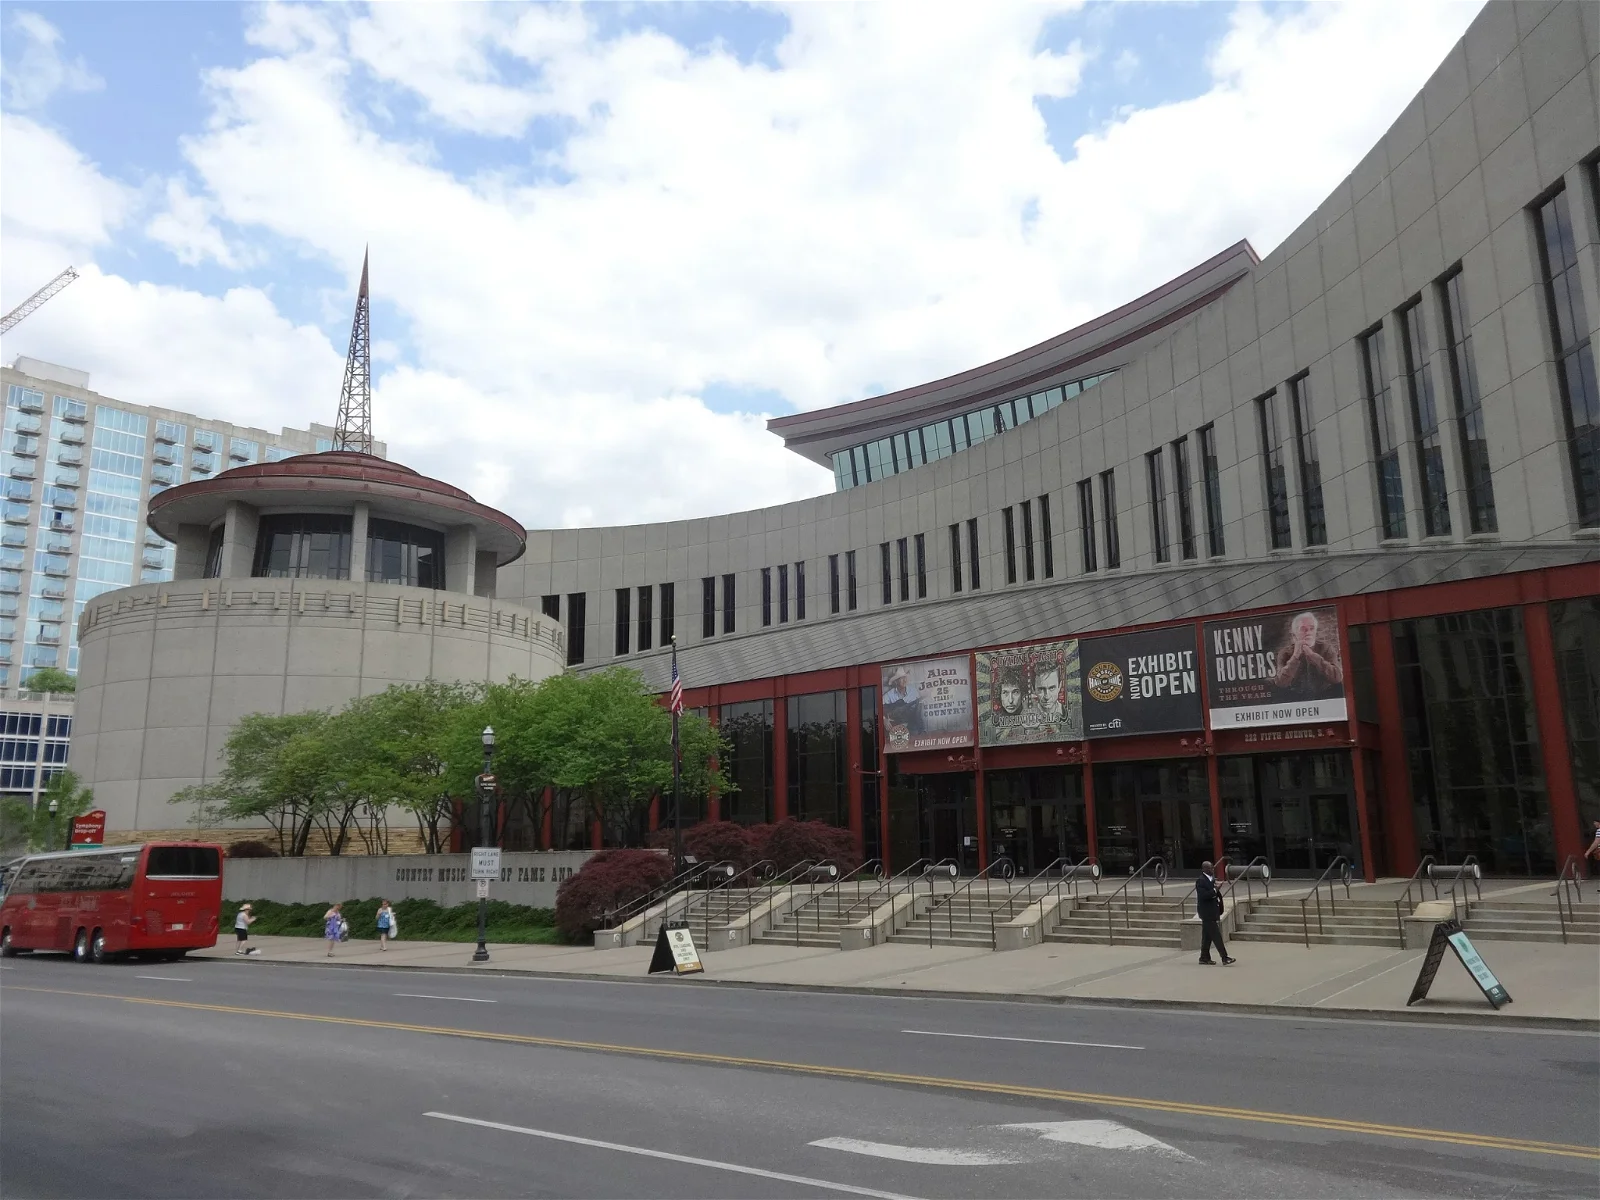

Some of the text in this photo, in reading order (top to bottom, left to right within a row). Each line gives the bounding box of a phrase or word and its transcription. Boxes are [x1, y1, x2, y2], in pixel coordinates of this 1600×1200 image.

[1213, 625, 1262, 654] KENNY
[1128, 651, 1192, 675] EXHIBIT
[1216, 652, 1276, 682] ROGERS
[927, 668, 957, 679] Alan
[918, 678, 968, 691] Jackson
[937, 687, 949, 695] 25
[1129, 677, 1140, 699] NOW
[1141, 671, 1196, 698] OPEN
[1219, 684, 1264, 694] THROUGH
[1219, 692, 1272, 701] THE YEARS
[923, 708, 966, 717] COUNTRY
[1235, 707, 1319, 721] EXHIBIT NOW OPEN
[1108, 718, 1122, 729] citi
[914, 735, 968, 747] EXHIBIT NOW OPEN
[1245, 733, 1257, 742] 222
[1260, 731, 1282, 741] FIFTH
[1285, 729, 1316, 739] AVENUE,
[395, 867, 573, 882] COUNTRY MUSIC OF FAME AND
